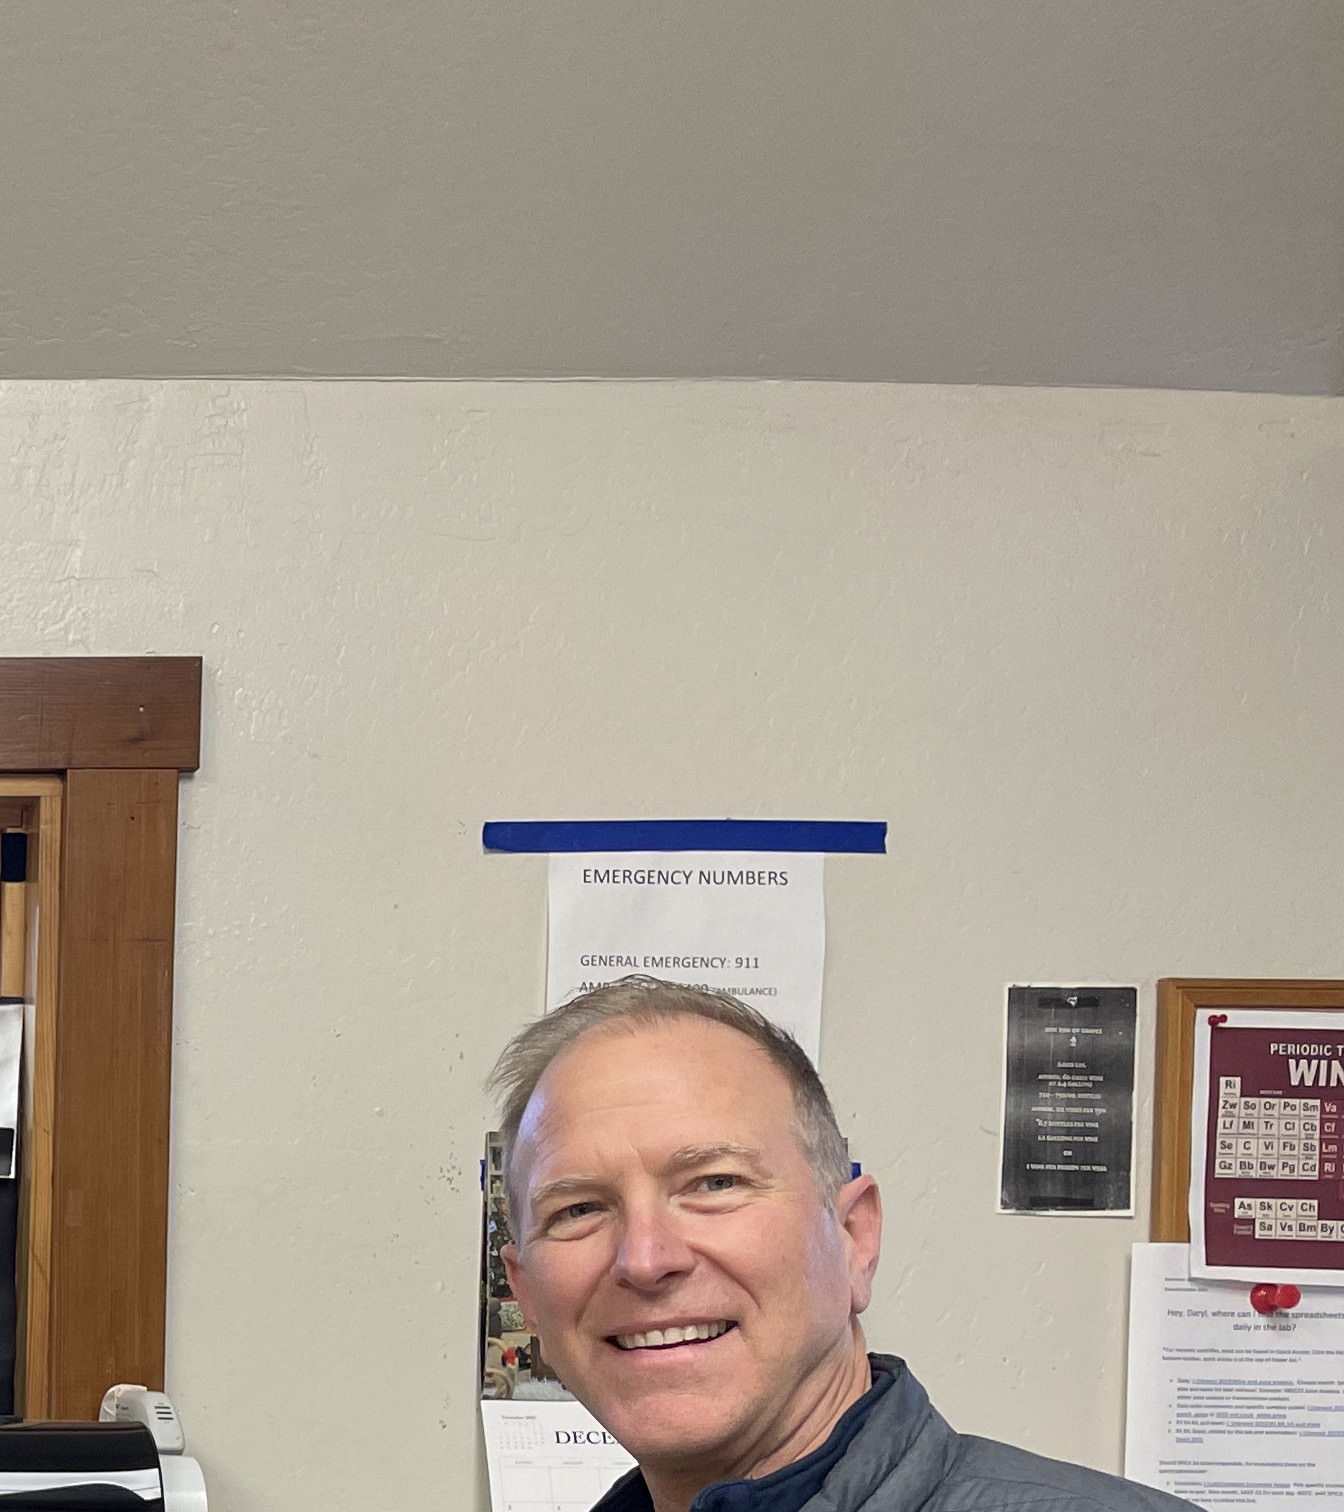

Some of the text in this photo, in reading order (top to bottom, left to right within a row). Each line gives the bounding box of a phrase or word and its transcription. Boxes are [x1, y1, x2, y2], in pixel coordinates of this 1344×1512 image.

[583, 868, 789, 886] EMERGENCY NUMBERS
[580, 954, 759, 969] GENERAL EMERGENCY: 911
[1270, 1043, 1332, 1056] PERIODIC
[1222, 1100, 1238, 1110] Zw
[1243, 1101, 1256, 1110] So
[1264, 1101, 1276, 1111] Or
[1283, 1102, 1297, 1111] Po
[1302, 1102, 1319, 1112] Sm
[1264, 1121, 1274, 1130] Tr
[1302, 1122, 1317, 1132] Cb
[1243, 1141, 1252, 1151] C
[1303, 1142, 1317, 1152] Sb
[1239, 1161, 1254, 1171] Bb
[1260, 1161, 1276, 1171] Bw
[1282, 1161, 1296, 1174] Pg
[1302, 1162, 1317, 1172] Cd
[1238, 1201, 1252, 1211] As
[1259, 1201, 1273, 1211] Sk
[1279, 1202, 1294, 1211] Cv
[1300, 1202, 1316, 1212] Ch
[1259, 1222, 1273, 1232] Sa
[1279, 1222, 1293, 1232] Vs
[1298, 1223, 1317, 1232] Bm
[1321, 1224, 1335, 1235] By
[1211, 1310, 1235, 1318] where
[1233, 1323, 1251, 1332] daily
[1263, 1323, 1277, 1331] the
[1279, 1323, 1297, 1331] lab?
